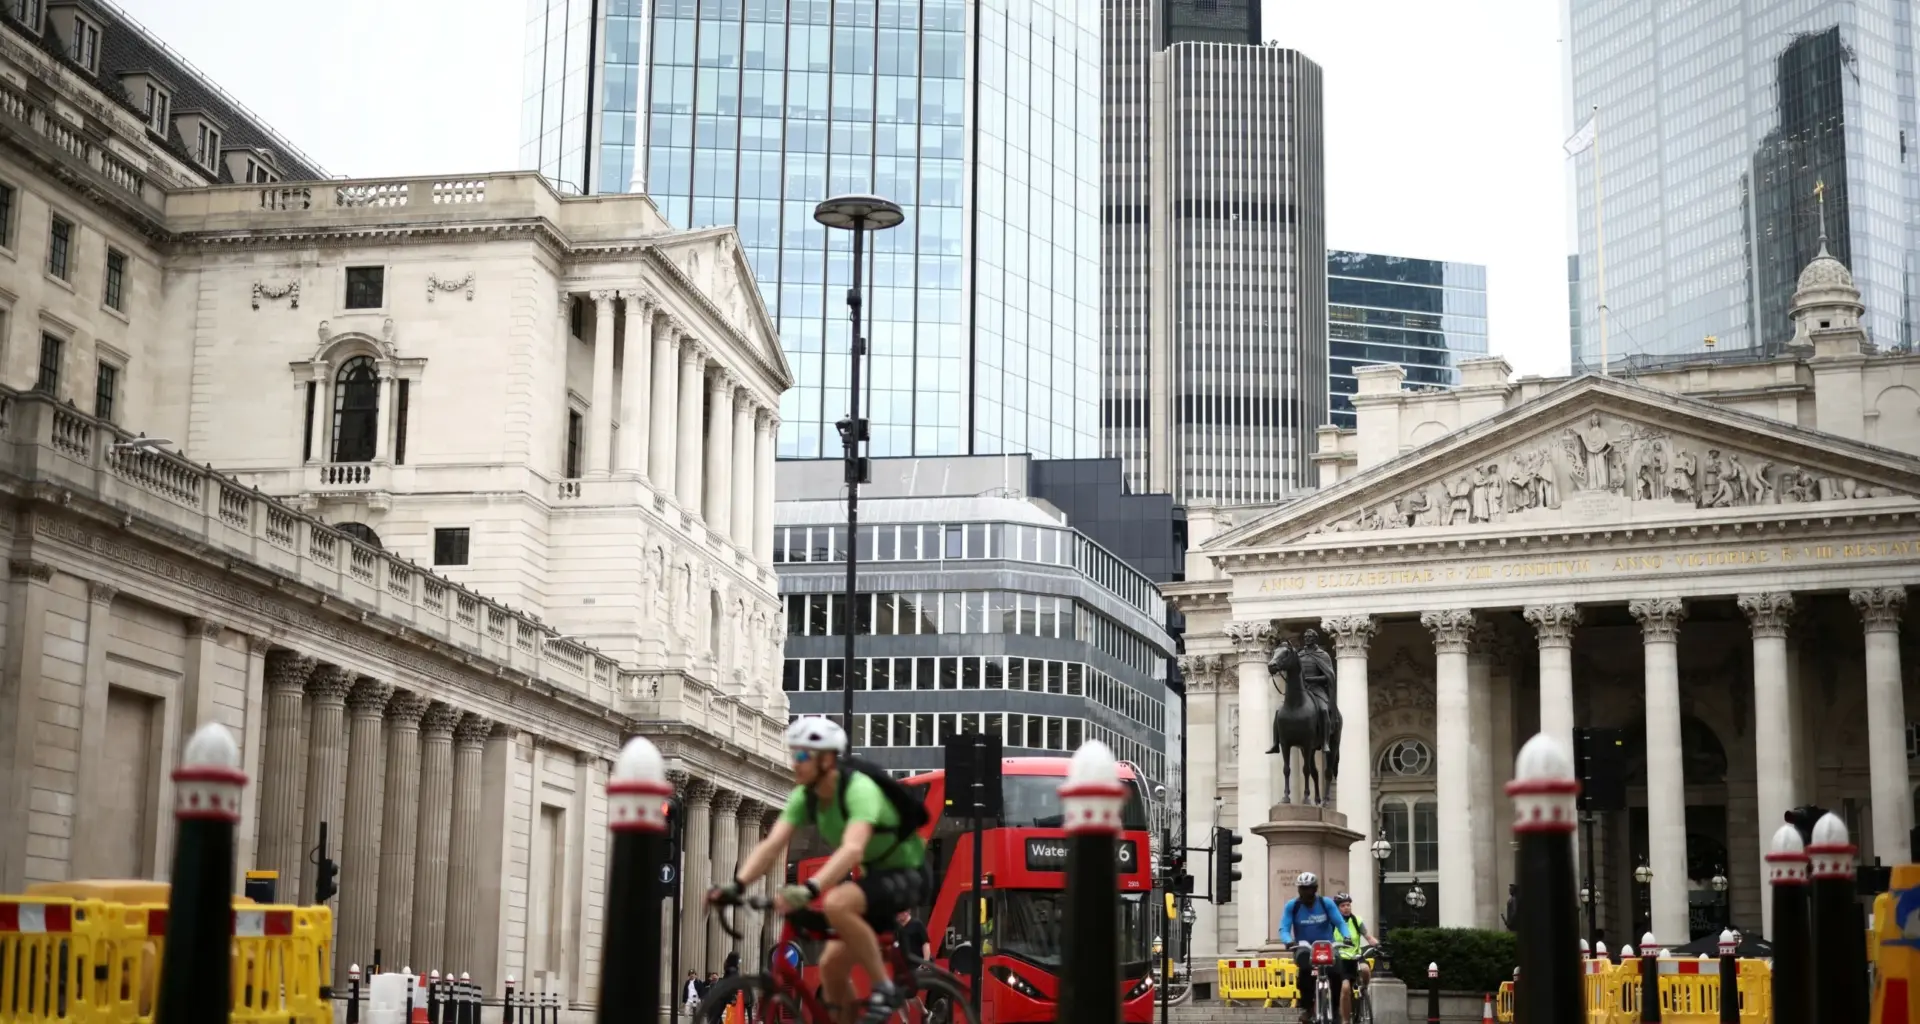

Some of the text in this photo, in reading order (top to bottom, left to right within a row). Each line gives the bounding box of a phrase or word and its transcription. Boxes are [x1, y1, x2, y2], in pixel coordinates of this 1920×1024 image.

[1258, 576, 1305, 592] ANNO
[1316, 569, 1435, 588] ELIZABETHAE
[1501, 558, 1591, 578] CONDITVM
[1612, 555, 1663, 571] ANNO
[1674, 550, 1771, 568] VICTORIAE
[1803, 544, 1833, 559] VIII
[1031, 843, 1069, 857] Water
[1117, 843, 1130, 862] 6
